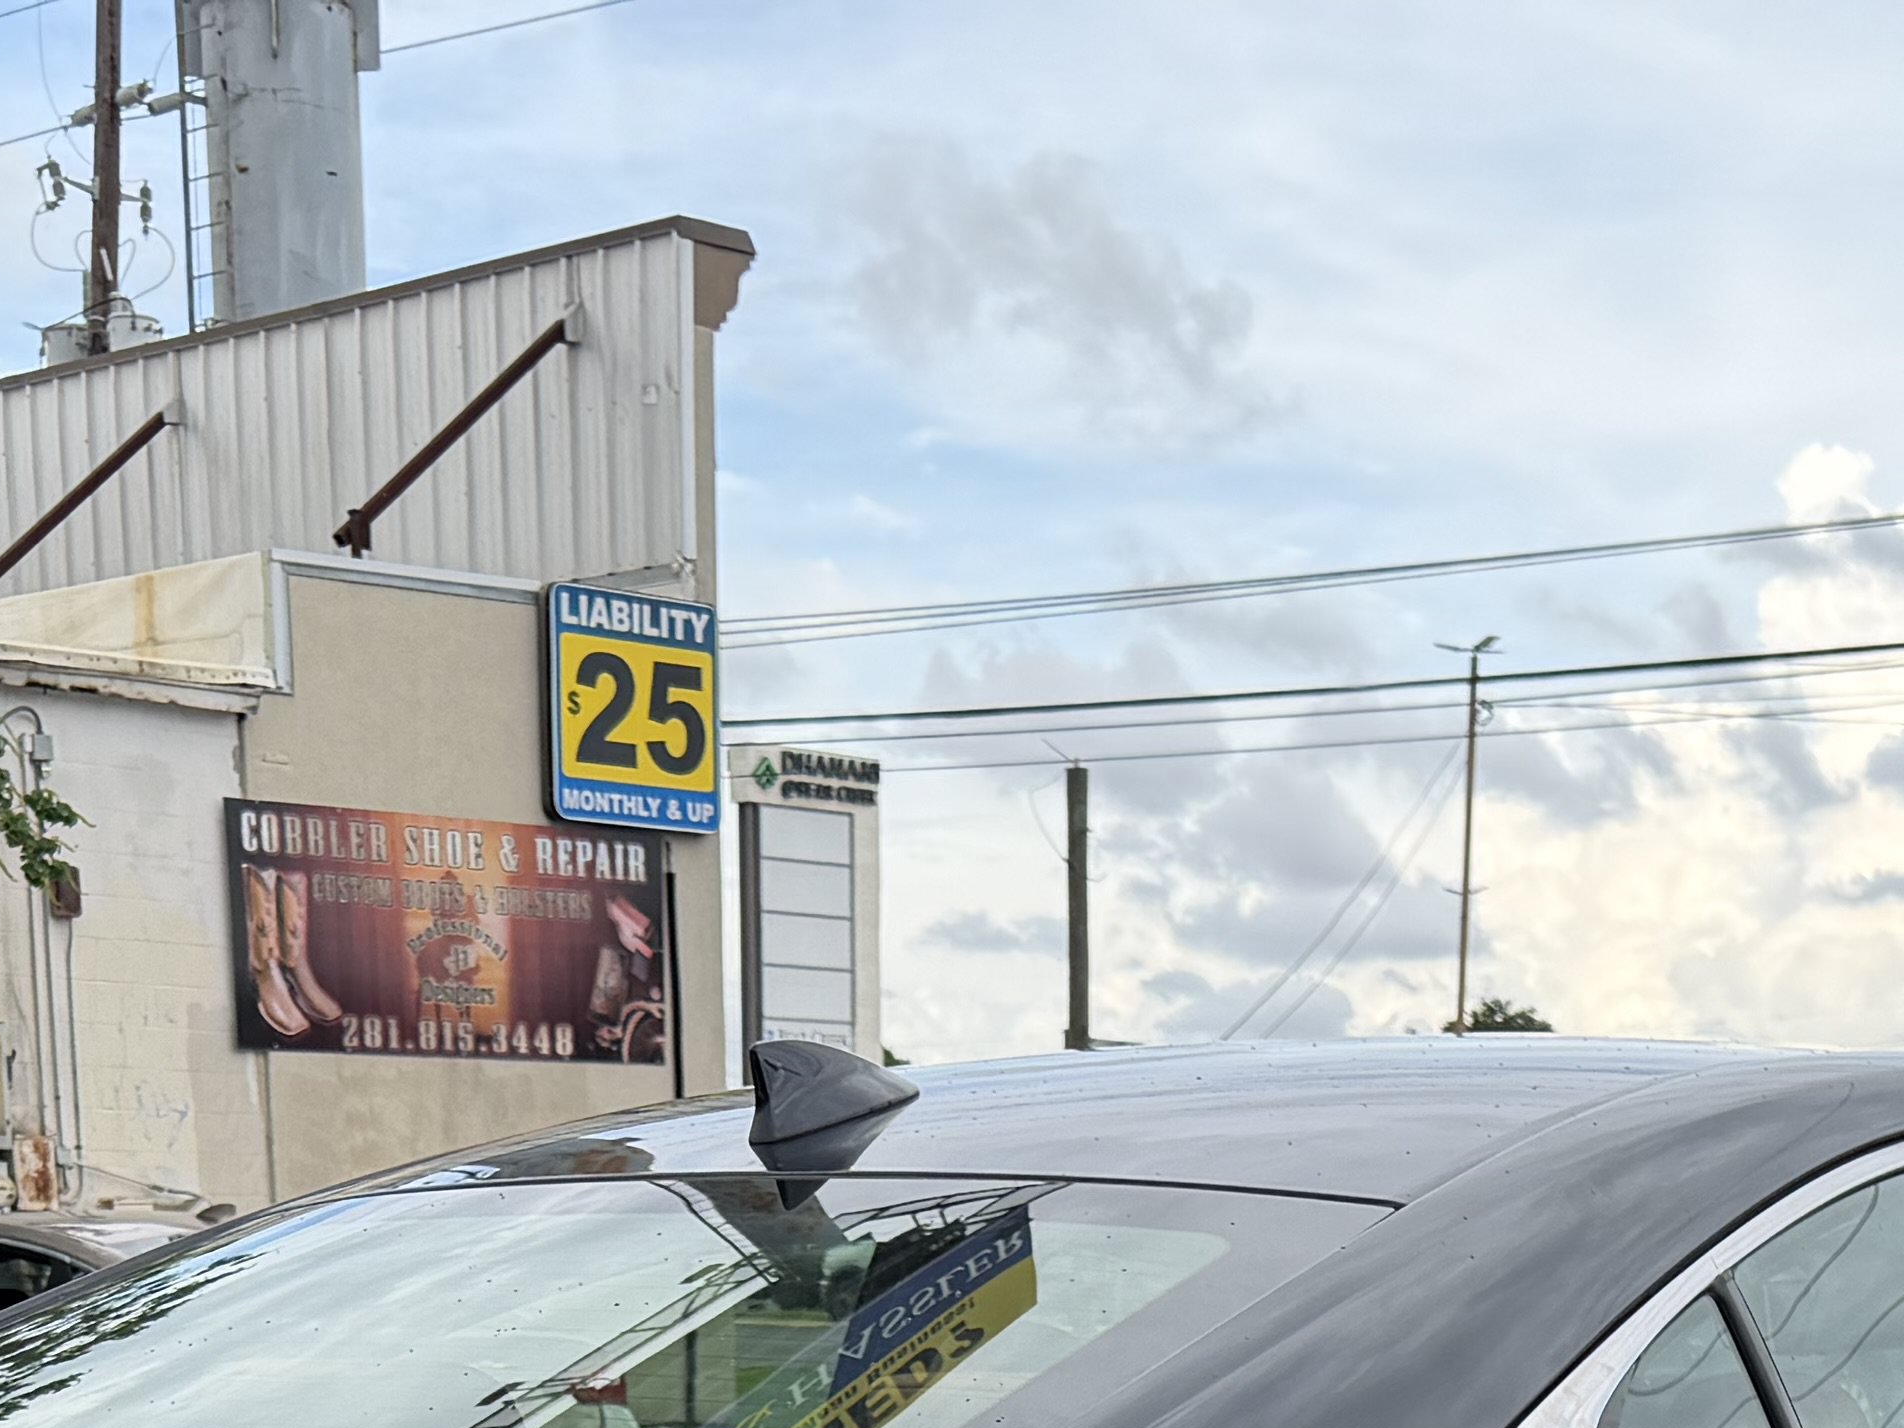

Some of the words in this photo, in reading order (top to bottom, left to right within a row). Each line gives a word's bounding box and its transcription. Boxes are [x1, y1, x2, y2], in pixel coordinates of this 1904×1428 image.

[560, 592, 710, 644] LIABILITY
[562, 788, 662, 818] MONTHLY
[666, 799, 683, 821] &
[686, 802, 715, 824] UP
[240, 810, 390, 864] COBBLER
[403, 825, 486, 872] SHOE
[498, 835, 520, 874] &
[534, 837, 648, 884] REPAIR
[312, 873, 394, 908] CUSTOM
[401, 878, 466, 915] BOOTS
[472, 884, 488, 915] &
[493, 886, 593, 922] HOLSTERS
[406, 918, 508, 963] Professional
[420, 979, 496, 1010] Designers
[341, 1013, 576, 1058] 281.815.3448
